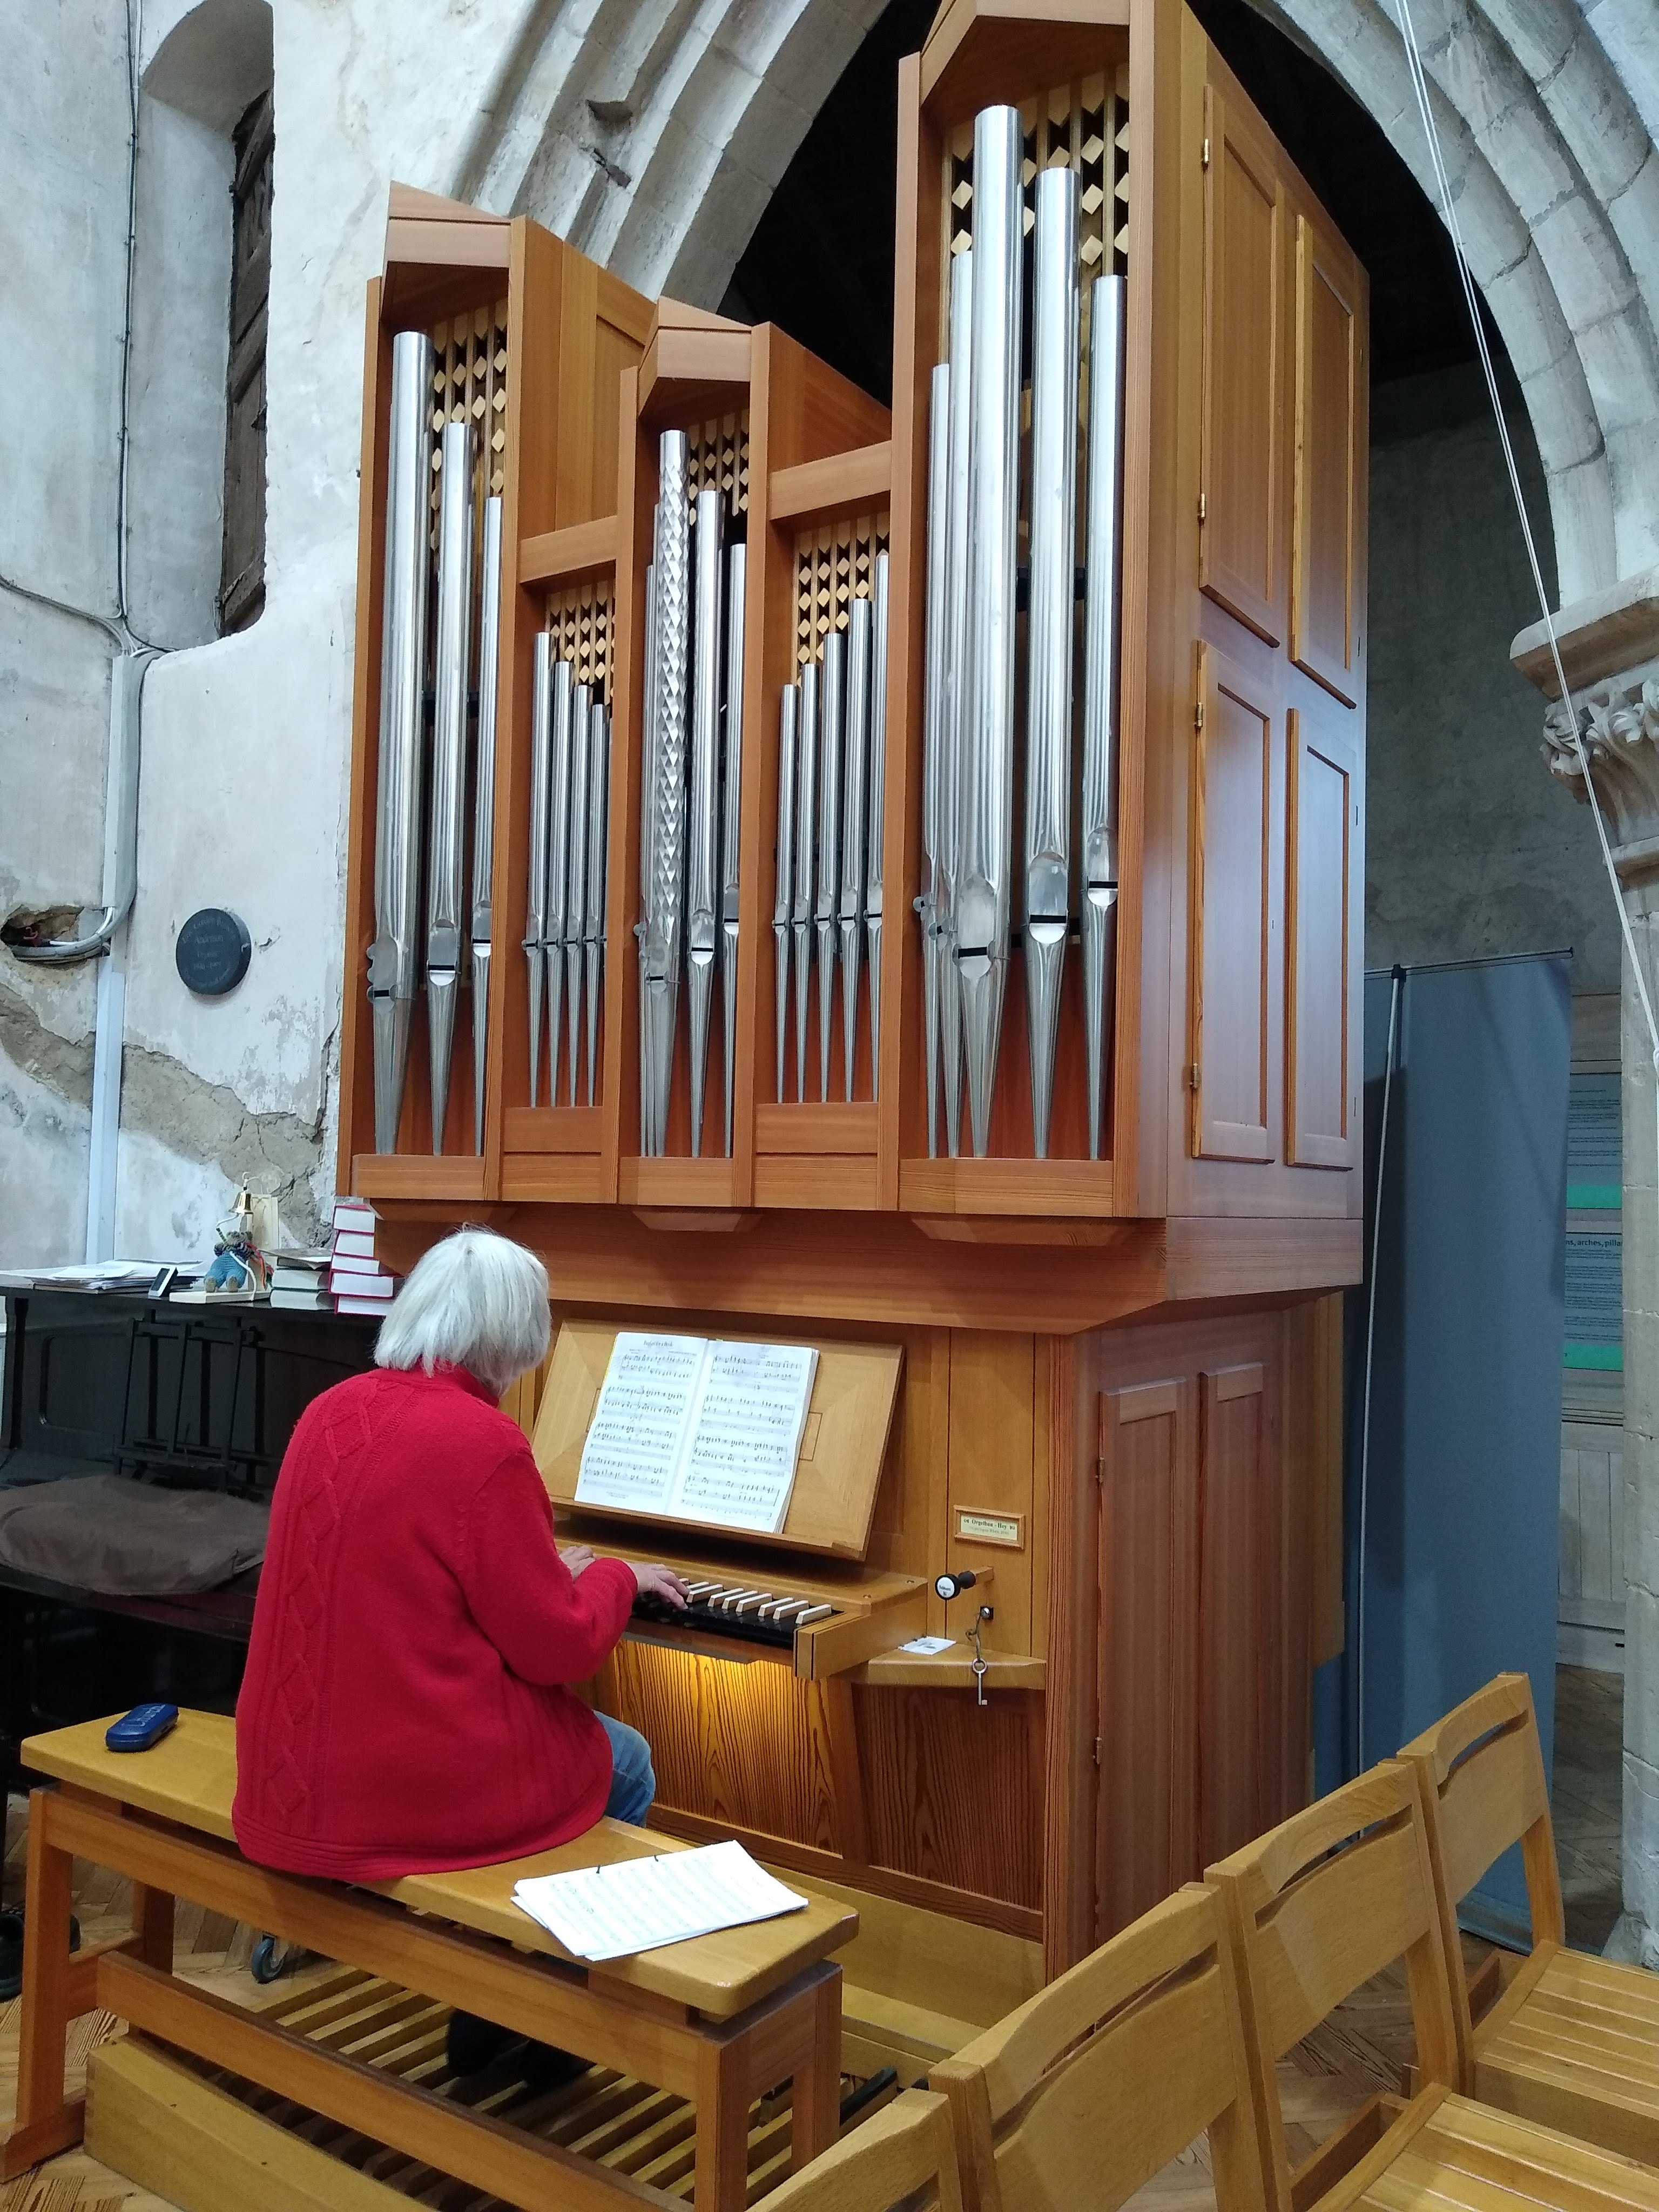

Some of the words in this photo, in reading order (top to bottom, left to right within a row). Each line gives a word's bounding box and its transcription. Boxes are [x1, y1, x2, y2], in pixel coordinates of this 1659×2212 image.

[1577, 1239, 1603, 1247] arches,
[972, 1519, 993, 1527] Orgelbau
[997, 1522, 1007, 1530] Hey
